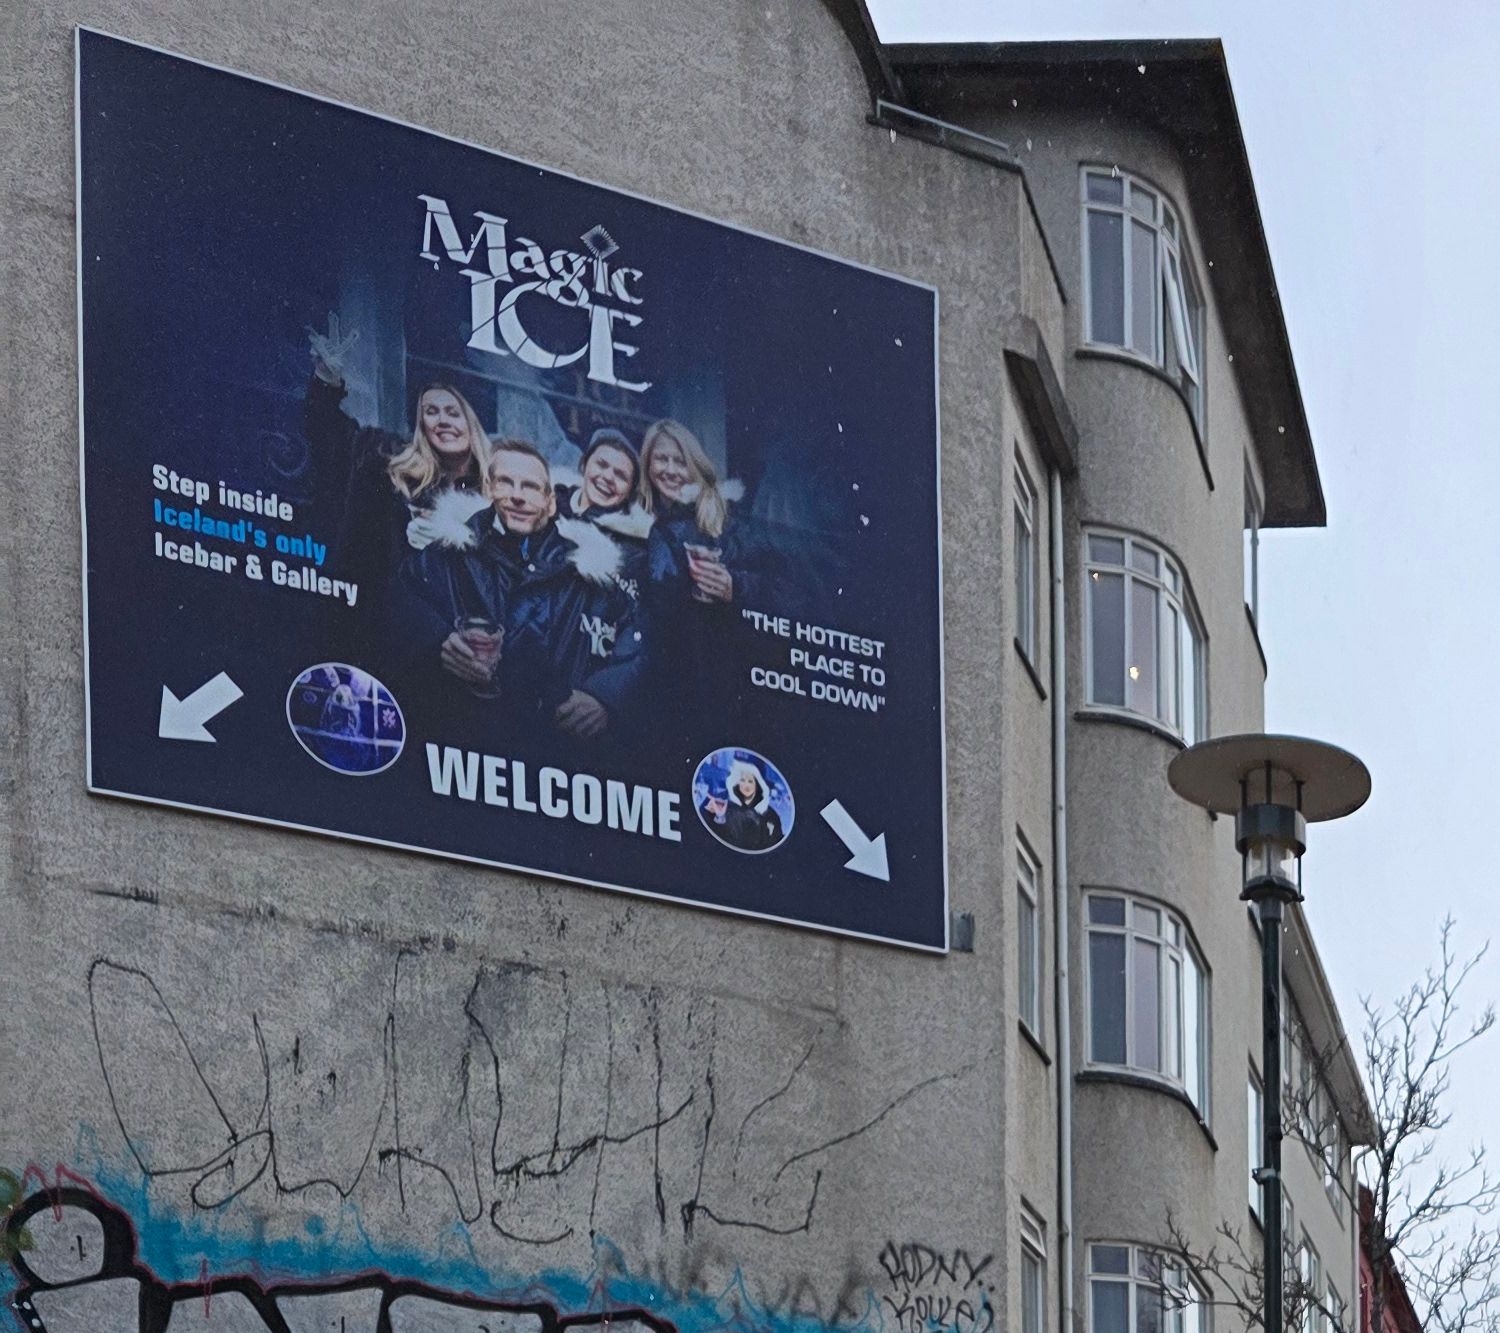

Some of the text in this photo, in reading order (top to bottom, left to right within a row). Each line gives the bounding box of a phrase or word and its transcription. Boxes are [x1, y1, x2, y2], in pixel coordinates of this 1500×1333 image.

[417, 194, 644, 308] Magic
[458, 268, 653, 393] ICE
[152, 463, 294, 522] Step inside
[154, 498, 327, 566] Iceland's only
[154, 531, 358, 607] Icebar & Gallery
[741, 608, 886, 660] "THE HOTTEST
[790, 647, 886, 687] PLACE TO
[750, 666, 886, 713] COOL DOWN"
[424, 742, 683, 843] WELCOME
